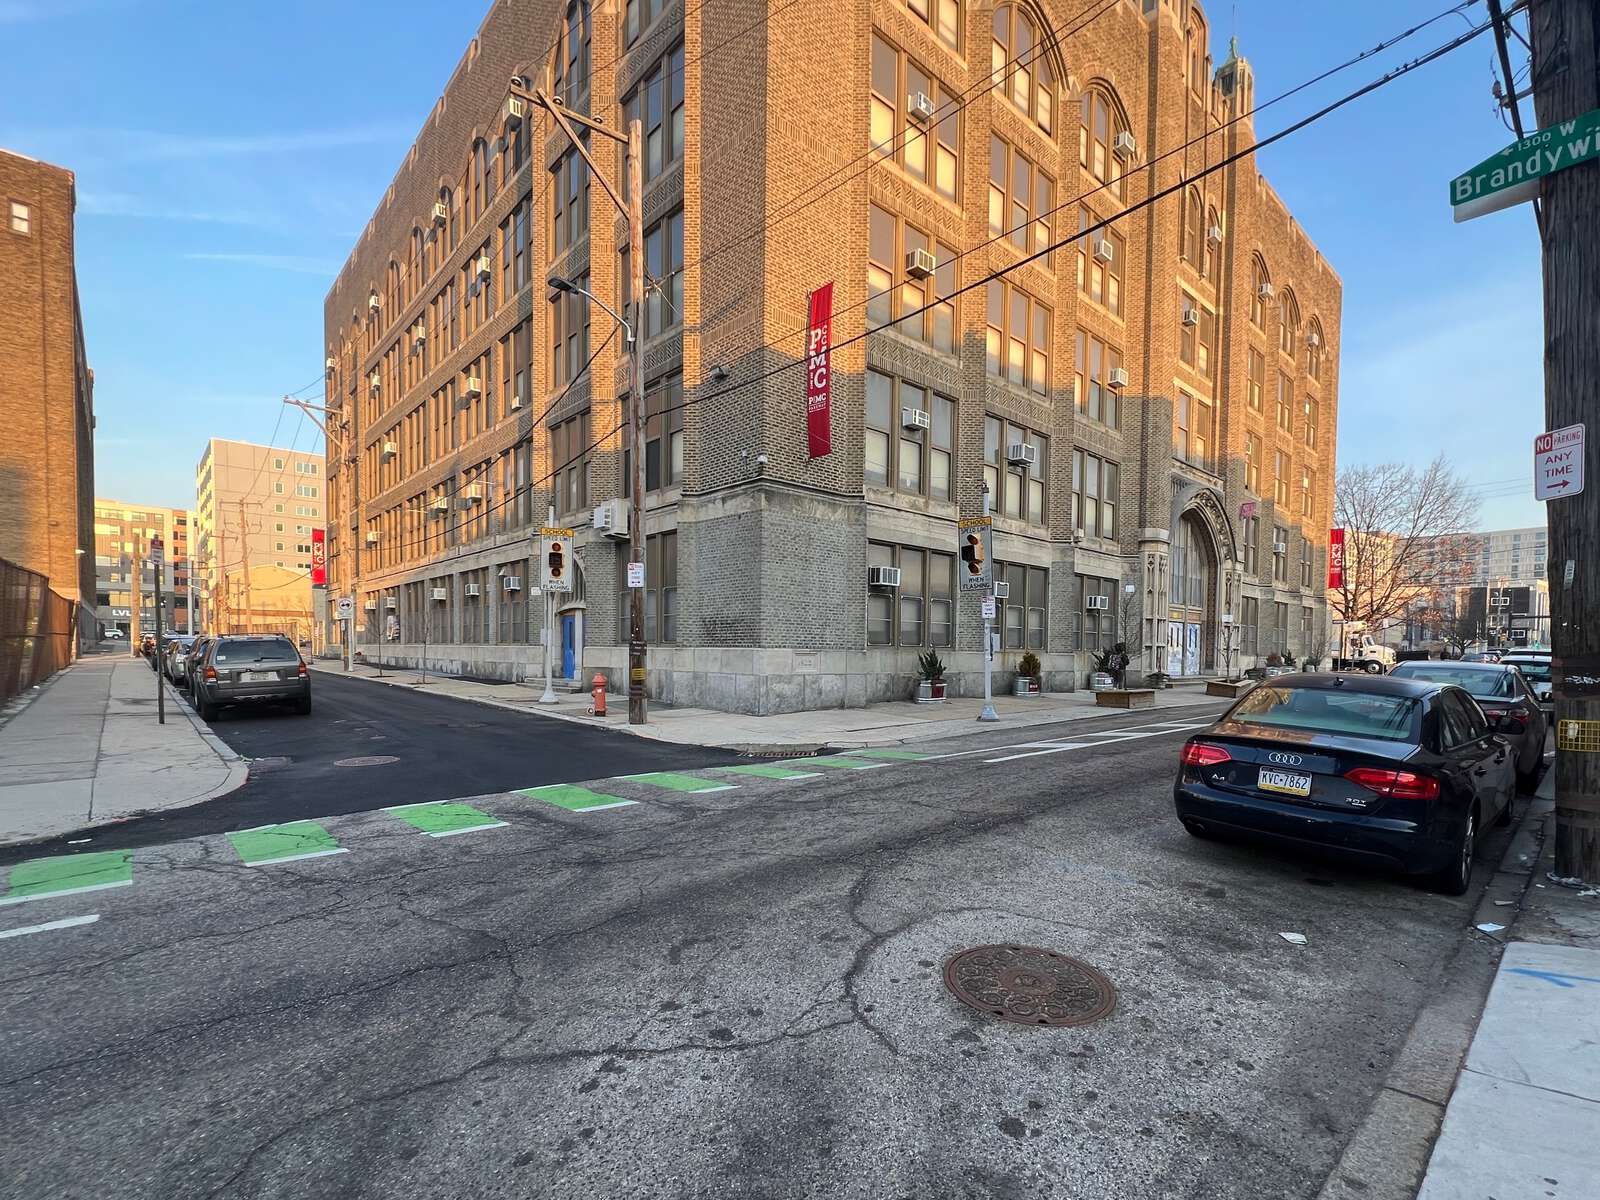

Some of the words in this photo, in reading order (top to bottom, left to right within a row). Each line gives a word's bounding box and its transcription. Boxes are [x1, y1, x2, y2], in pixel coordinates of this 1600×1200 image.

[1518, 132, 1551, 151] 1300
[1559, 120, 1576, 136] W
[1536, 437, 1551, 451] NO
[1553, 431, 1581, 445] PARKING
[1545, 450, 1573, 465] ANY
[1545, 464, 1573, 479] TIME
